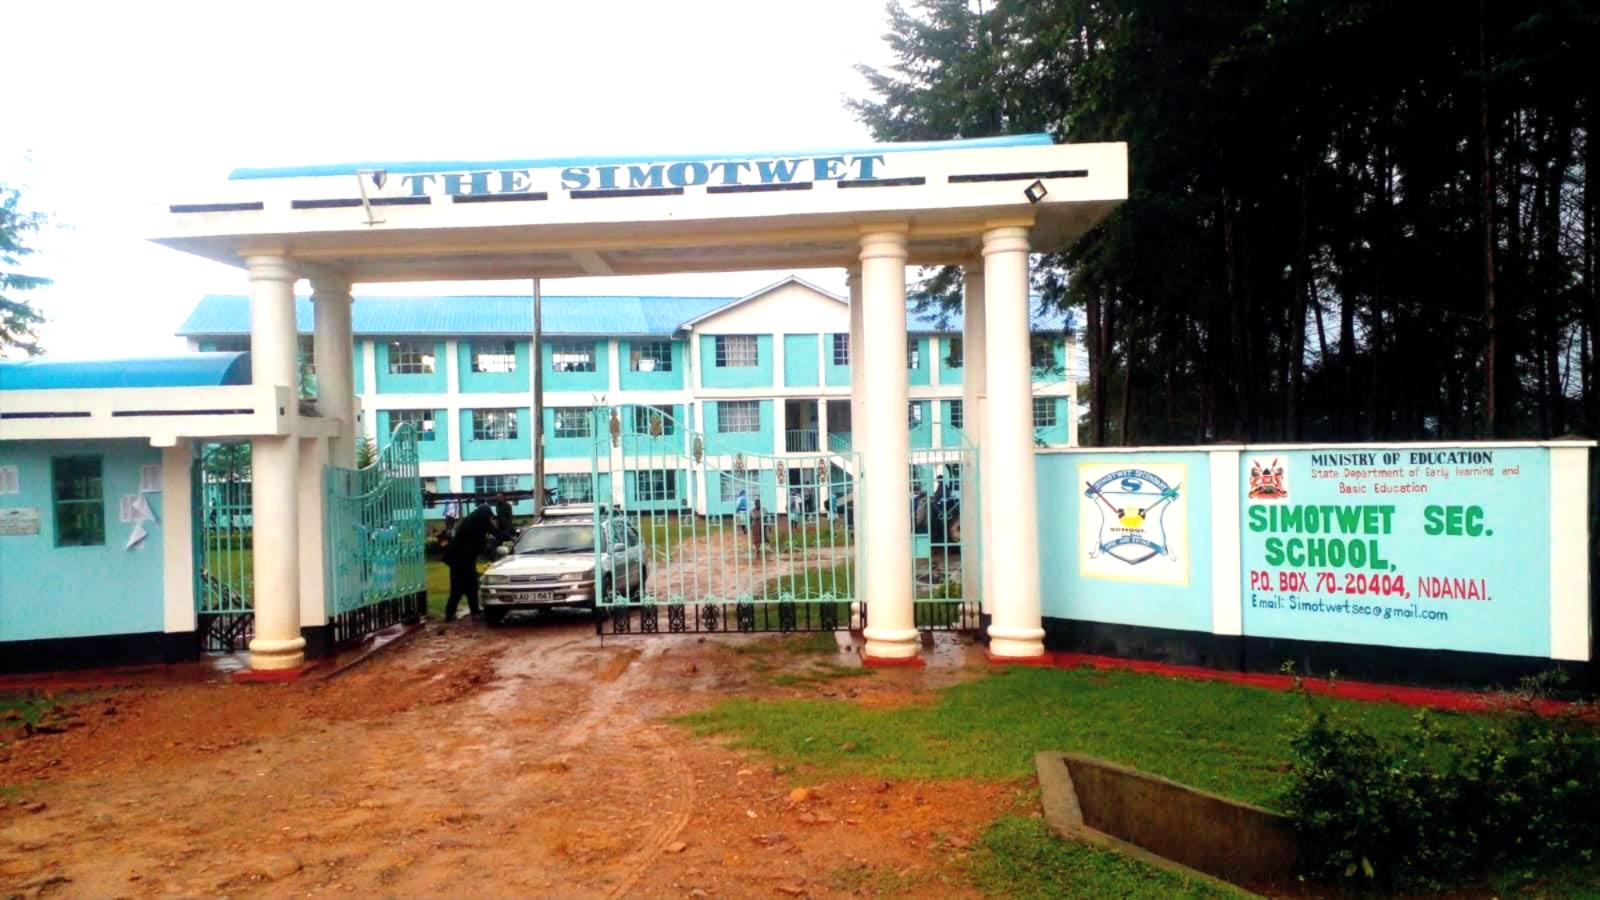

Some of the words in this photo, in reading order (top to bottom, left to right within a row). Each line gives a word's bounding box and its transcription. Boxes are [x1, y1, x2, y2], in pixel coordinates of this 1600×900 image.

[401, 170, 532, 196] THE
[561, 155, 885, 190] SIMOTWET
[1311, 454, 1376, 467] MINISTRY
[1383, 452, 1400, 465] OF
[1410, 451, 1493, 465] EDUCATION
[1311, 469, 1339, 478] State
[1344, 467, 1404, 479] Department
[1409, 467, 1420, 477] of
[1425, 467, 1449, 479] Early
[1456, 466, 1494, 476] learning
[1502, 465, 1520, 475] and
[1339, 482, 1366, 493] Basic
[1374, 481, 1427, 494] Education
[1248, 504, 1395, 534] SIMOTWET
[1423, 505, 1493, 537] SEC.
[1265, 537, 1397, 572] SCHOOL,
[1250, 571, 1274, 591] P.O.
[1279, 571, 1309, 592] BOX
[1316, 572, 1411, 599] 70-20404,
[1418, 576, 1492, 601] NDANAI.
